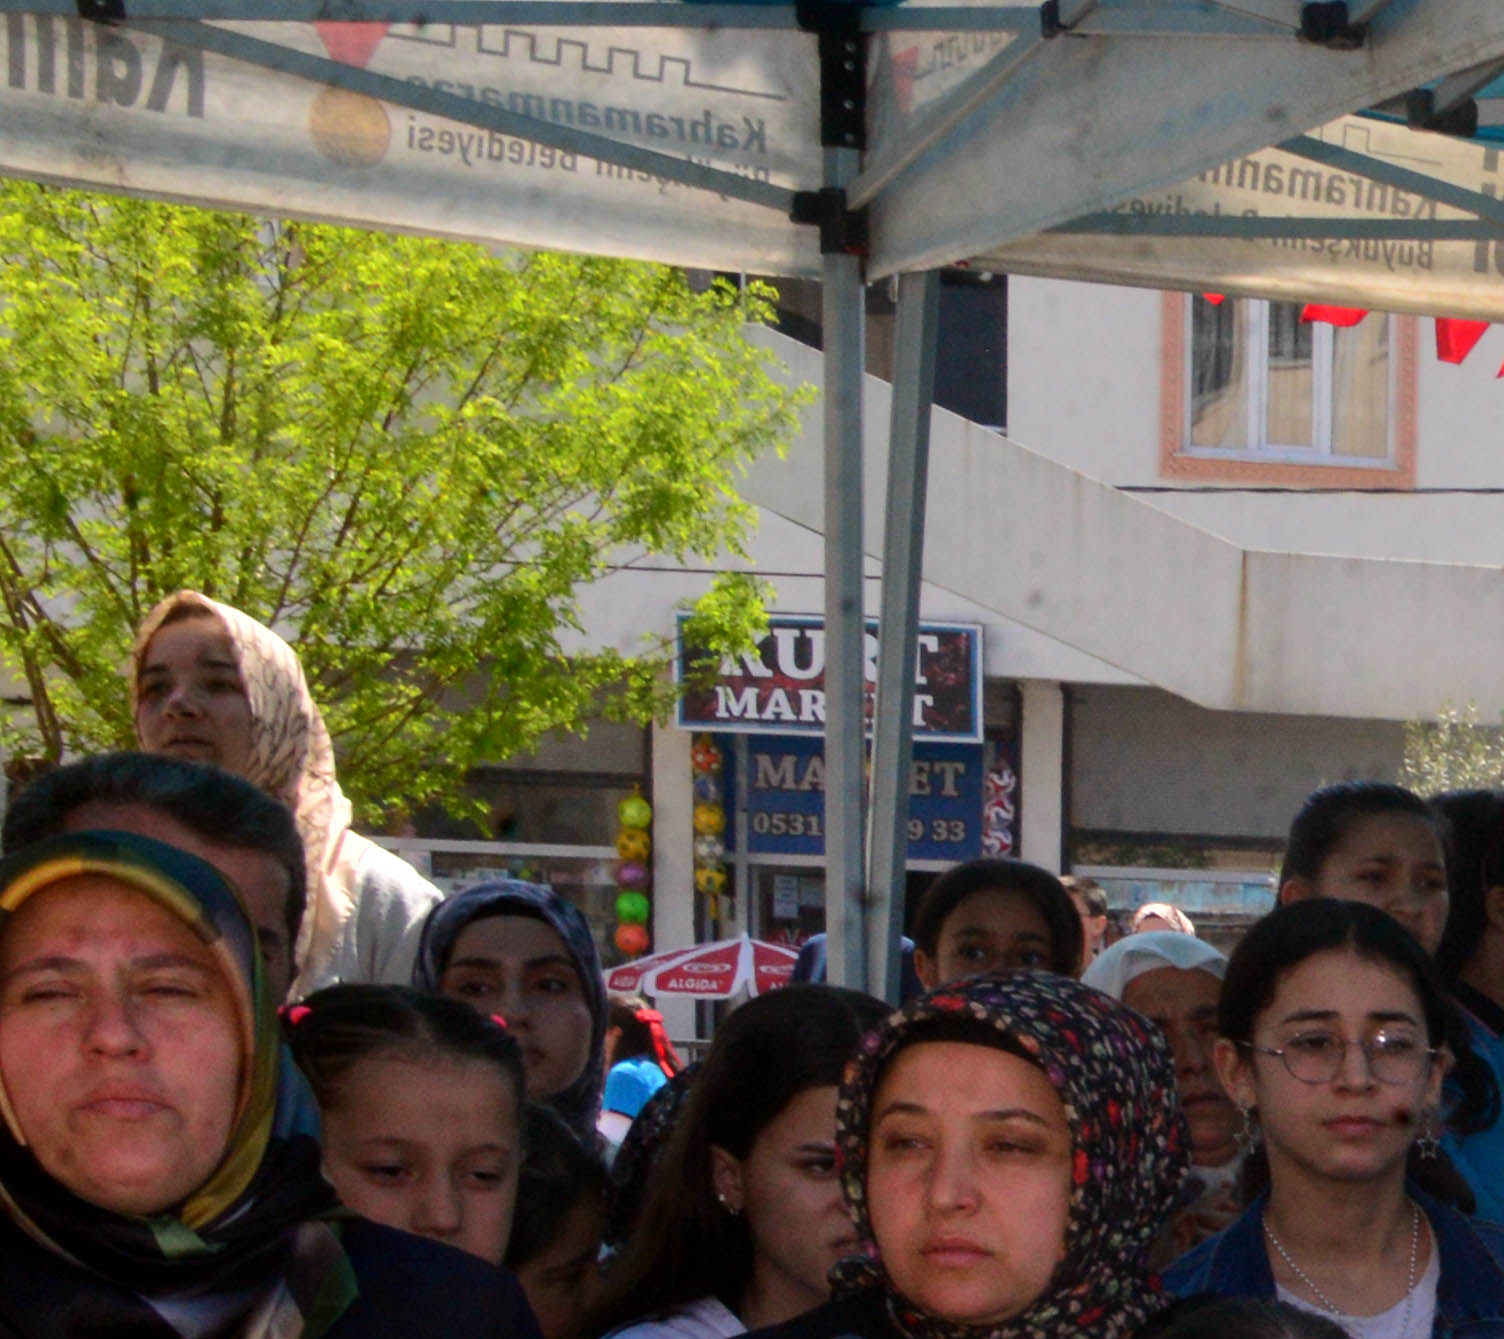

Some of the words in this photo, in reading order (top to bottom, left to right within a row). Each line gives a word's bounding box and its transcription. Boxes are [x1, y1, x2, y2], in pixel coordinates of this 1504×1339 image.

[715, 686, 933, 726] MART
[755, 754, 964, 797] MAET
[932, 820, 965, 841] 33
[668, 978, 718, 990] ALGIDA
